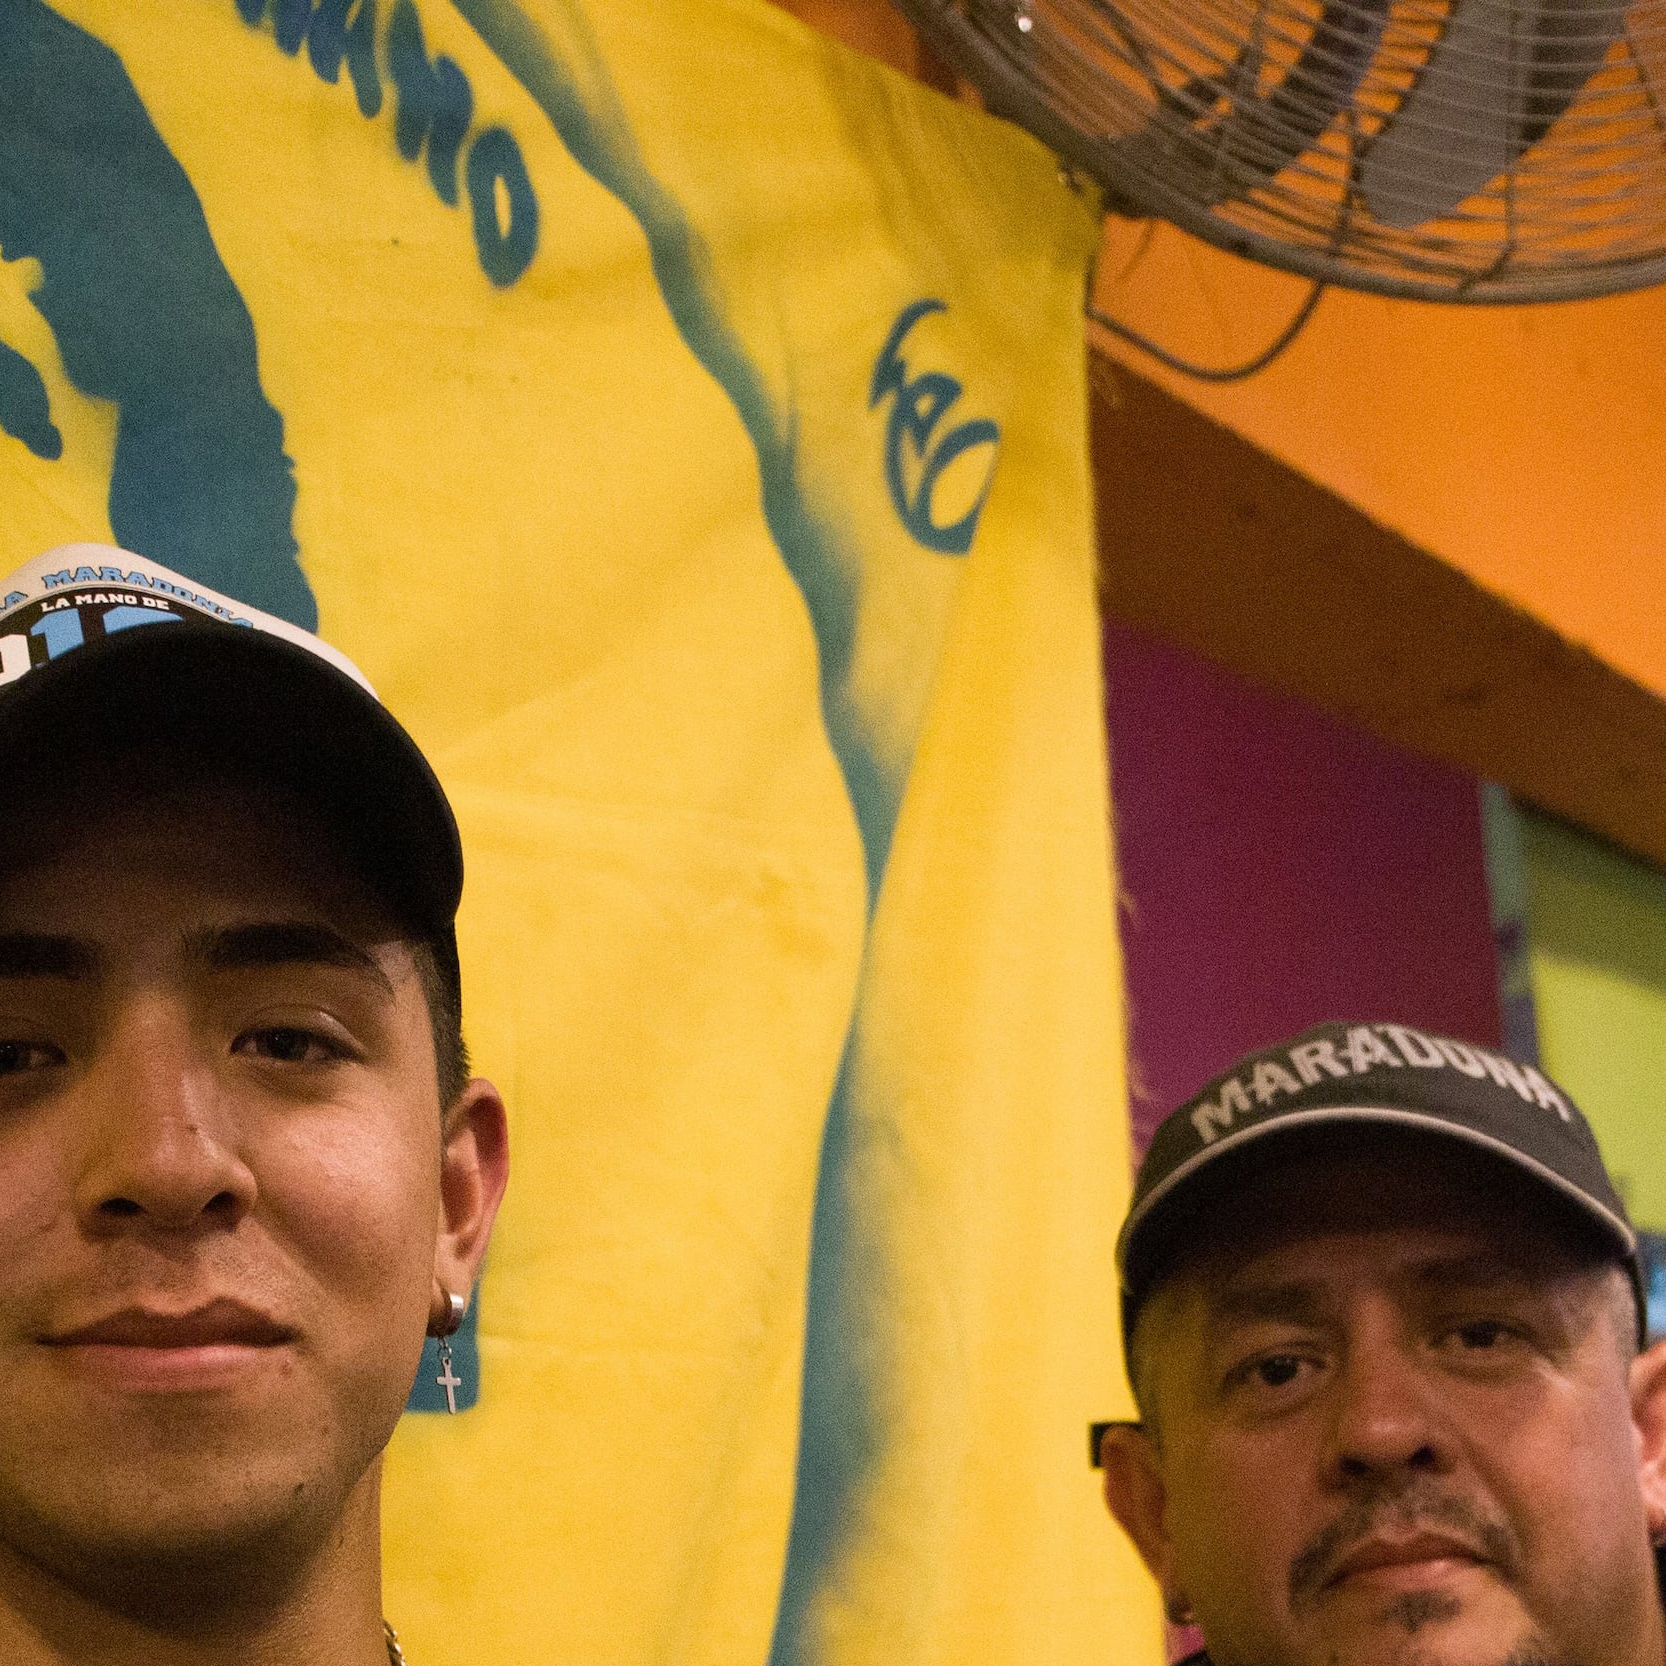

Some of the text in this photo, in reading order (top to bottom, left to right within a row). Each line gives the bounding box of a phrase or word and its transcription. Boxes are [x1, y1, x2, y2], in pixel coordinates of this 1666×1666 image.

[40, 593, 170, 613] LA MANO DE
[1188, 1022, 1574, 1146] MARADONA
